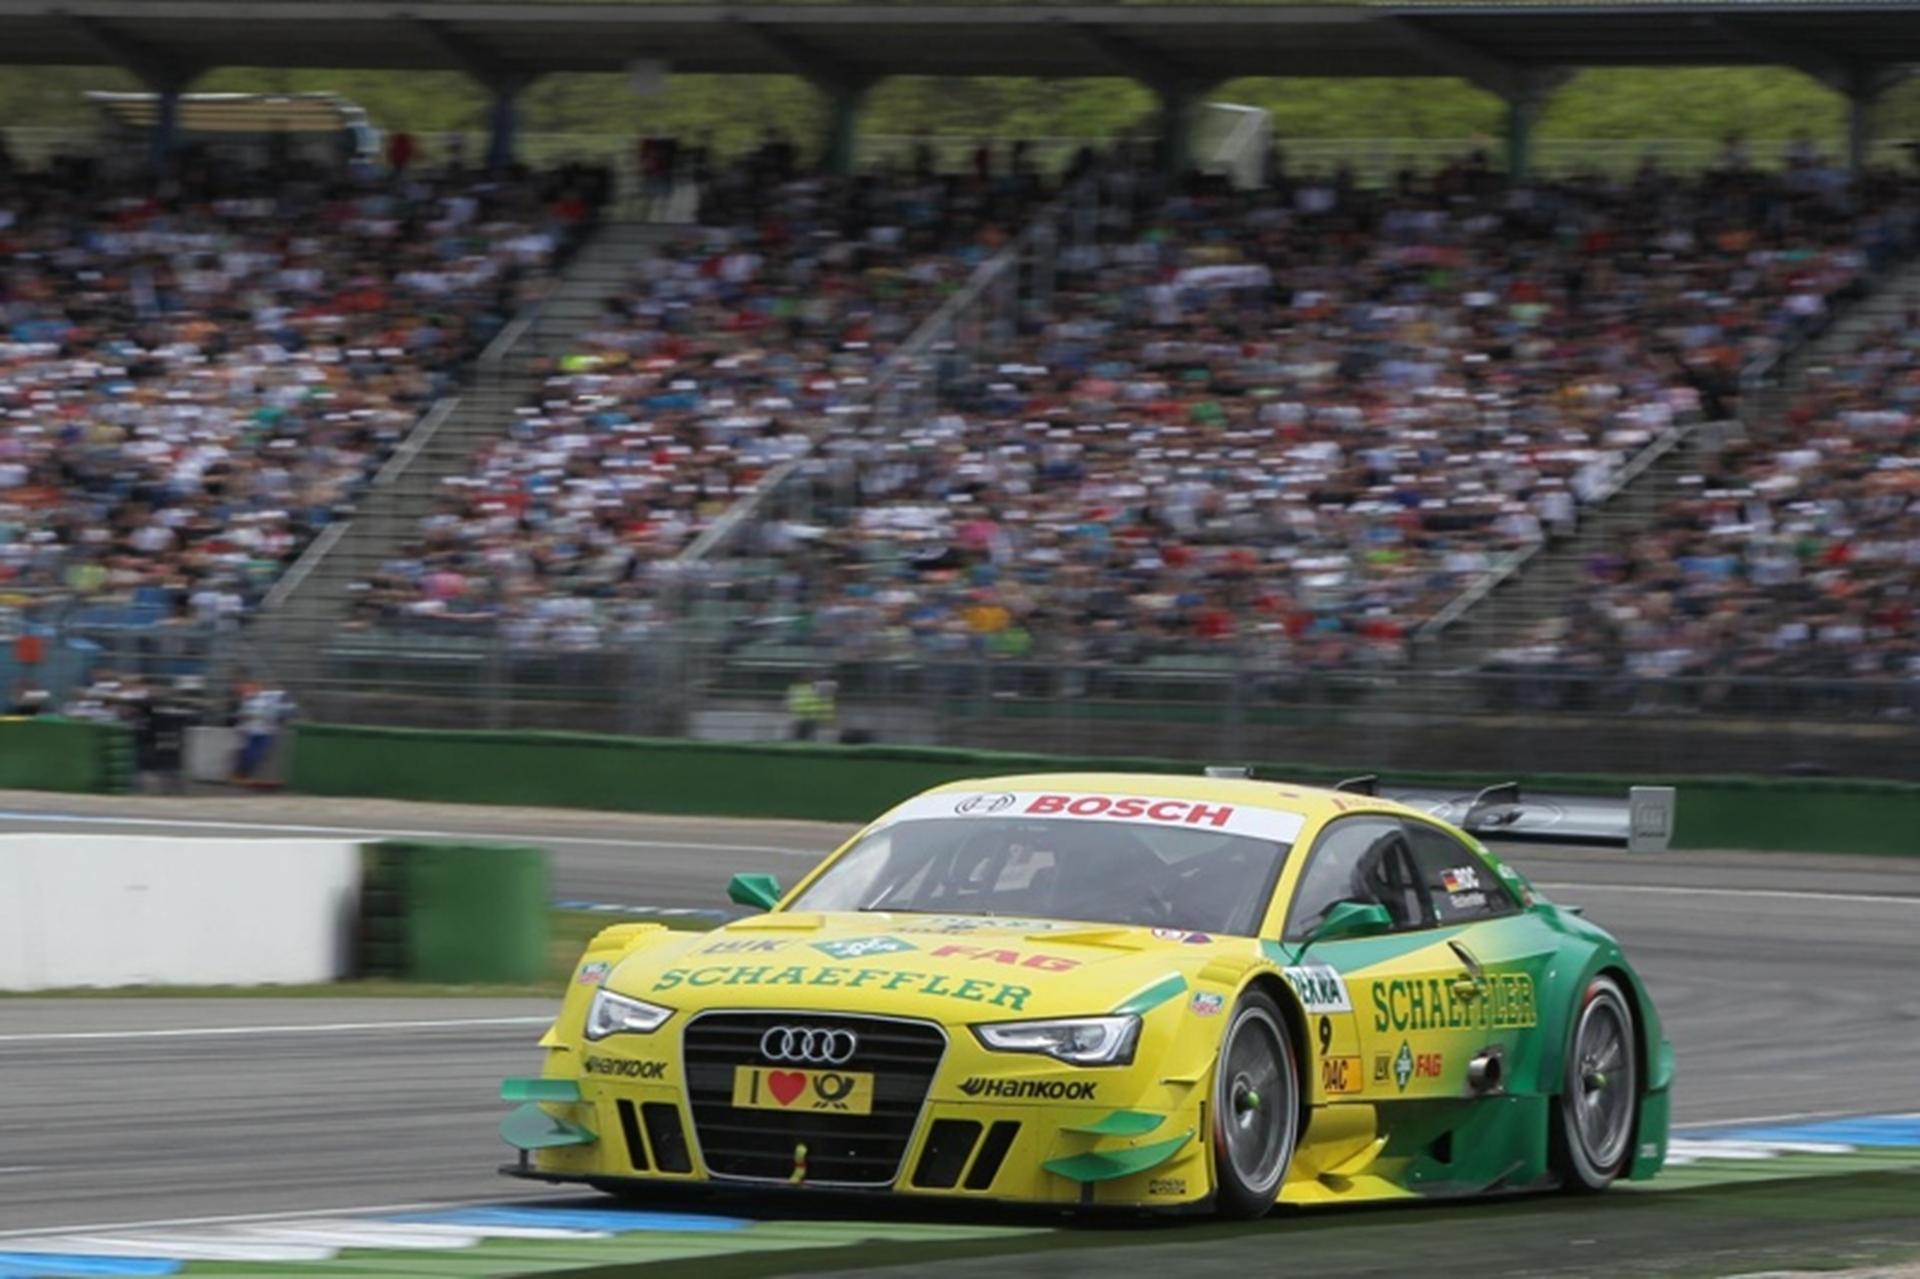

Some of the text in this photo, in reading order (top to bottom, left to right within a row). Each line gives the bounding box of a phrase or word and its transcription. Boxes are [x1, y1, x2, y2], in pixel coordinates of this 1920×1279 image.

[1024, 795, 1234, 826] BOSCH
[930, 944, 1082, 973] FAG
[652, 966, 1032, 1011] SCHAEFFLER
[1319, 1015, 1331, 1055] 9
[1415, 1053, 1443, 1078] FAG
